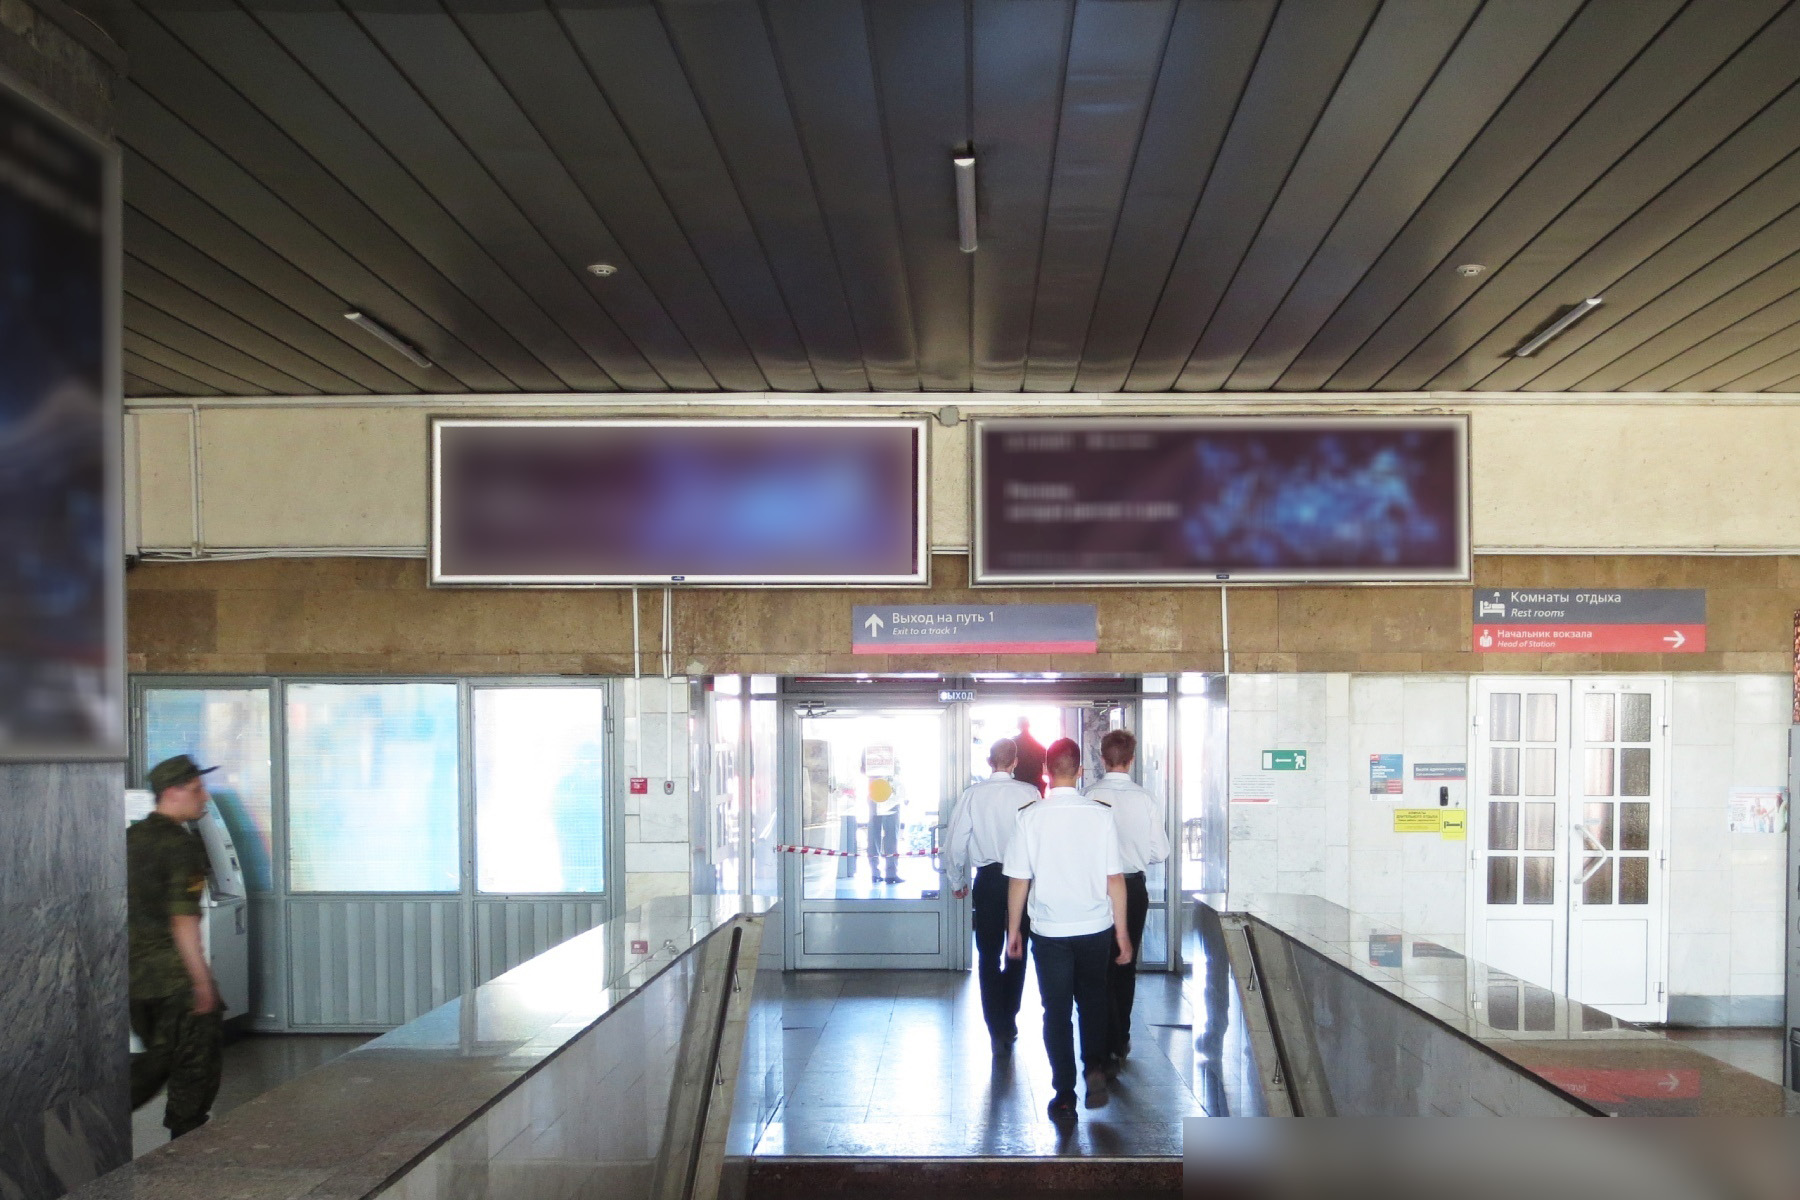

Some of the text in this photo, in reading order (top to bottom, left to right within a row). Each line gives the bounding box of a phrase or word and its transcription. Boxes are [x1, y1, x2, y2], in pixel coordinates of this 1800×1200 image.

[1510, 591, 1622, 605] Комнаты отдыха
[1511, 608, 1565, 618] Rest rooms
[892, 611, 994, 626] Выход на путь 1
[892, 627, 908, 635] Exit
[910, 627, 919, 635] to
[929, 626, 951, 635] track
[952, 626, 957, 635] 1
[1497, 630, 1593, 638] Начальник вокзала
[1519, 640, 1528, 648] of
[1528, 640, 1556, 648] Station
[940, 691, 976, 701] ЫХОД
